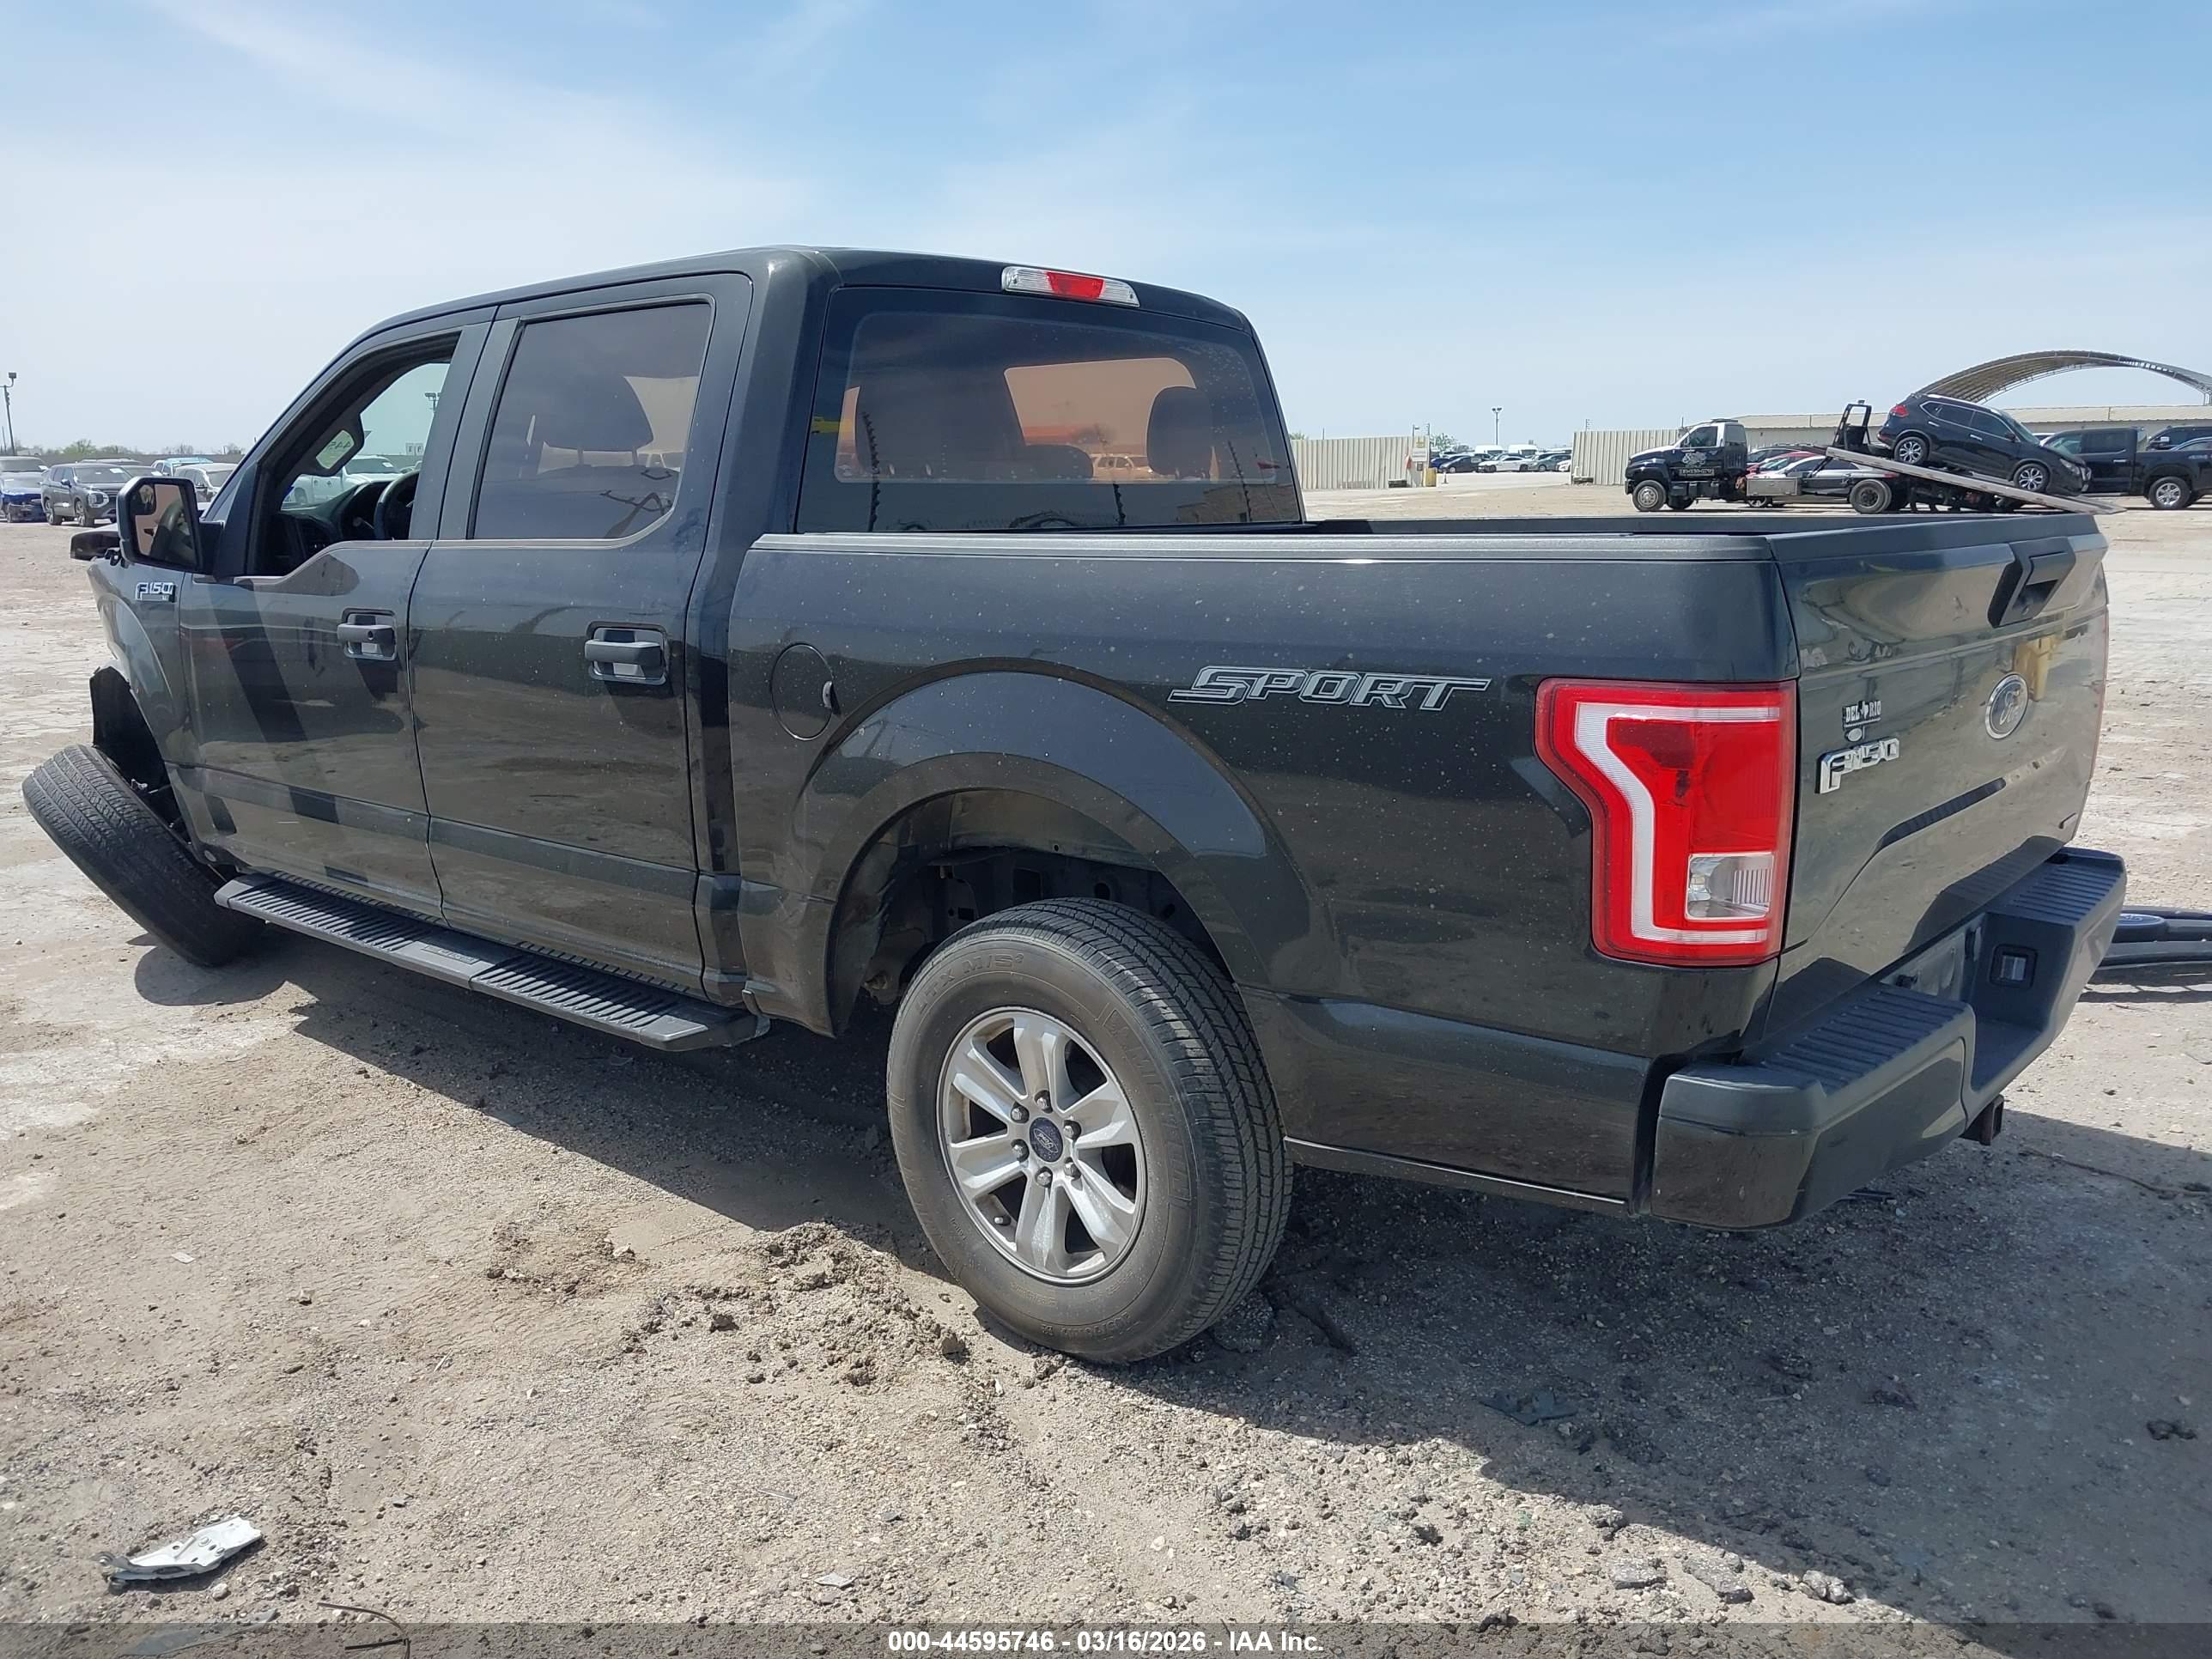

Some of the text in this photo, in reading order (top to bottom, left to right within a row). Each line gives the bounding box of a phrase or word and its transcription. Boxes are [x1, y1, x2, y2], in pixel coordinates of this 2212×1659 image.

[1166, 665, 1492, 712] SPORT
[1844, 700, 1882, 723] DEL RIO
